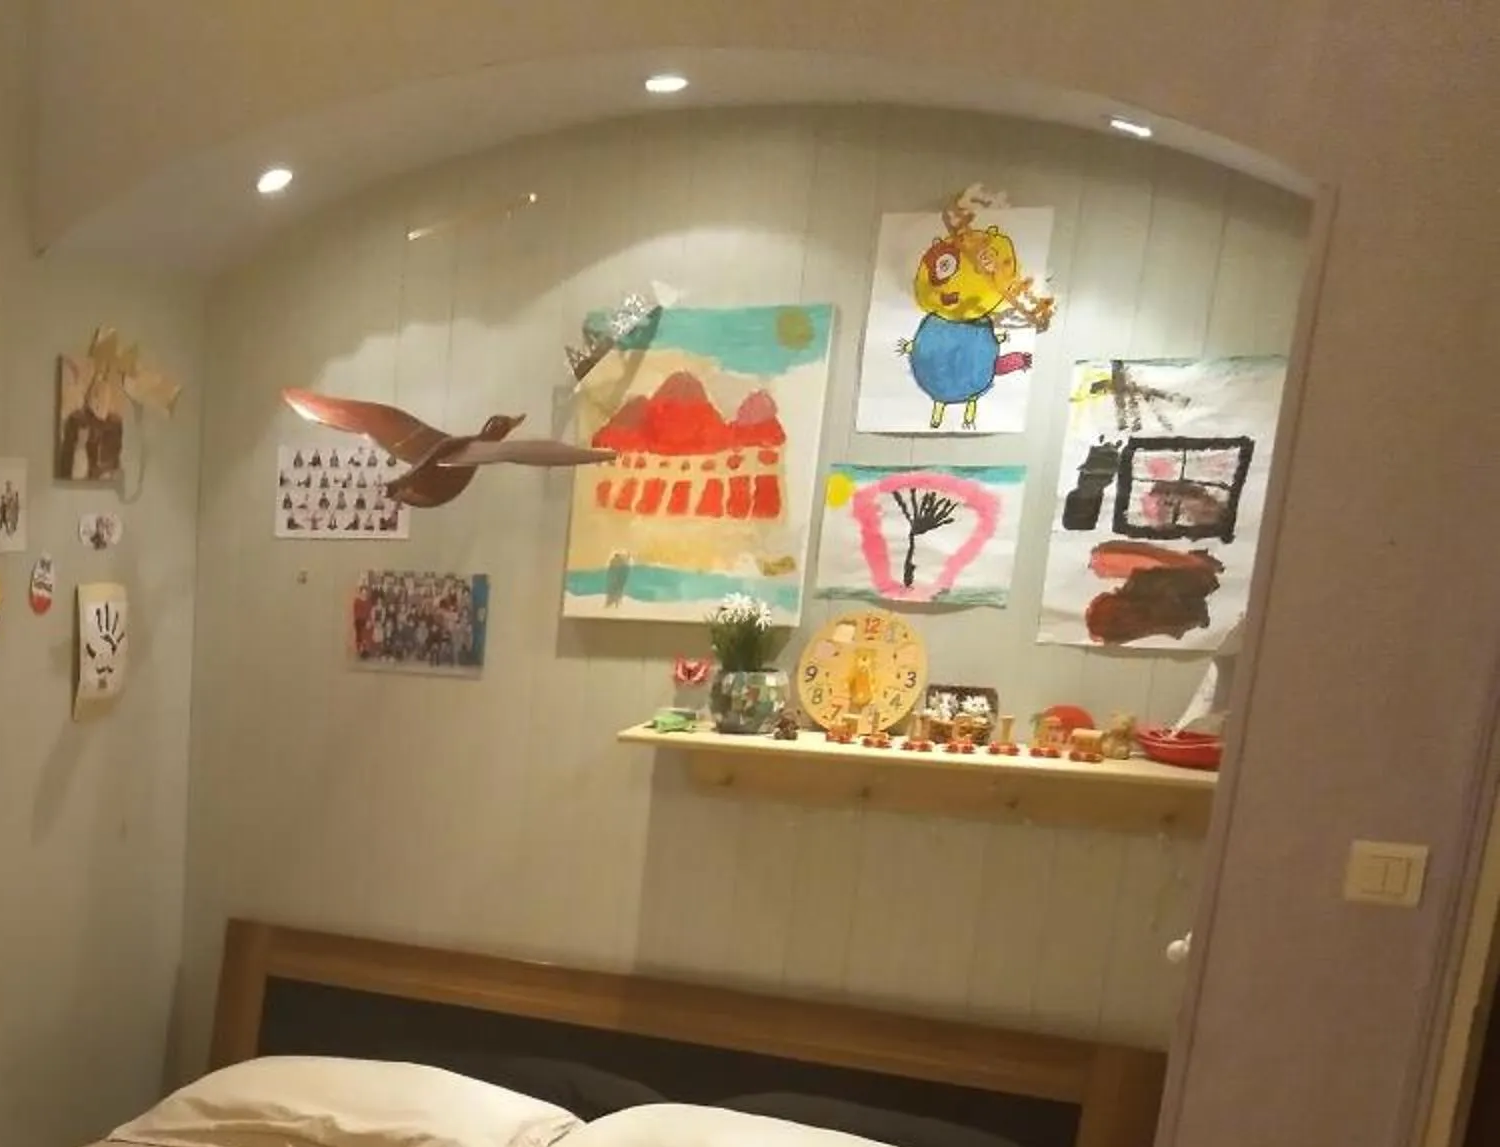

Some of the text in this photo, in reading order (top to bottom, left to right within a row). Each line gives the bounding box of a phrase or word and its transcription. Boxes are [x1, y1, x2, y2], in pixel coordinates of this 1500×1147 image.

[864, 617, 882, 635] 12
[804, 664, 819, 683] 9
[904, 671, 918, 689] 3
[811, 688, 824, 706] 8
[830, 703, 843, 721] 7
